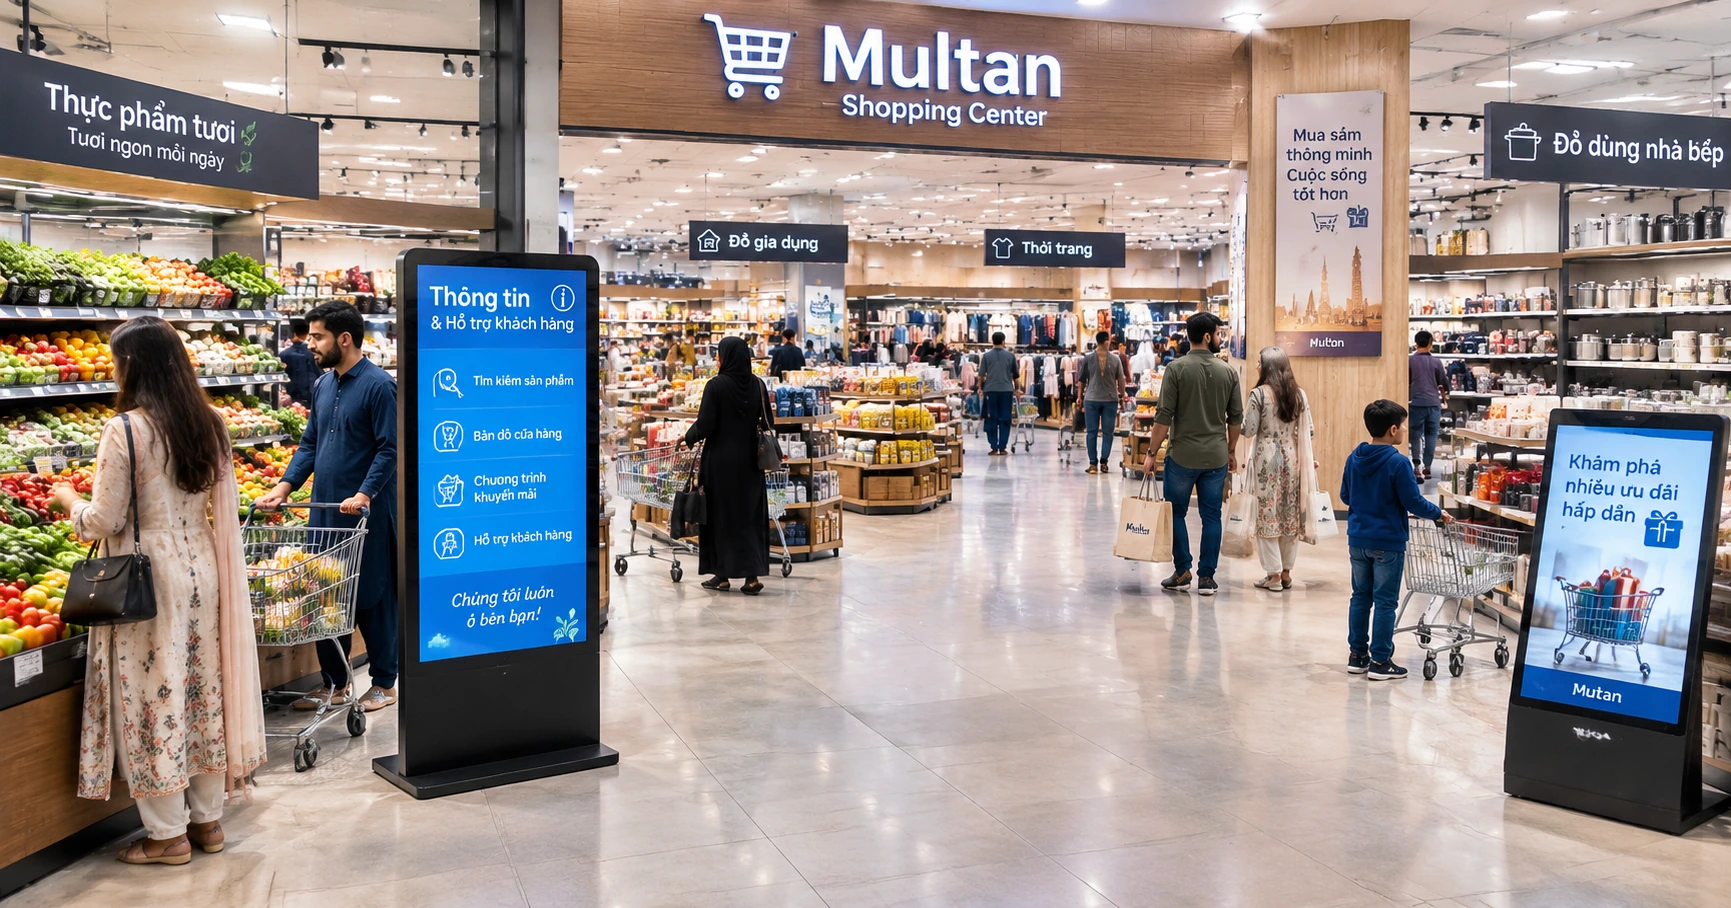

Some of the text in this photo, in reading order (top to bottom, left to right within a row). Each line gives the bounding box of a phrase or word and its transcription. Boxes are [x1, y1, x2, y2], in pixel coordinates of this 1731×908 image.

[823, 25, 1062, 98] Multan
[44, 81, 112, 124] Thực
[192, 114, 236, 144] tươi
[841, 94, 1048, 127] Shopping Center
[1293, 128, 1325, 141] Mua
[110, 138, 152, 159] ngon
[1286, 147, 1372, 165] thông minh
[1588, 134, 1640, 164] dùng
[1646, 138, 1683, 160] nhà
[754, 235, 777, 252] gia
[781, 235, 819, 253] dụng
[1055, 241, 1093, 259] trang
[502, 287, 530, 308] tin
[431, 315, 442, 330] &
[1572, 682, 1622, 704] Mutan
